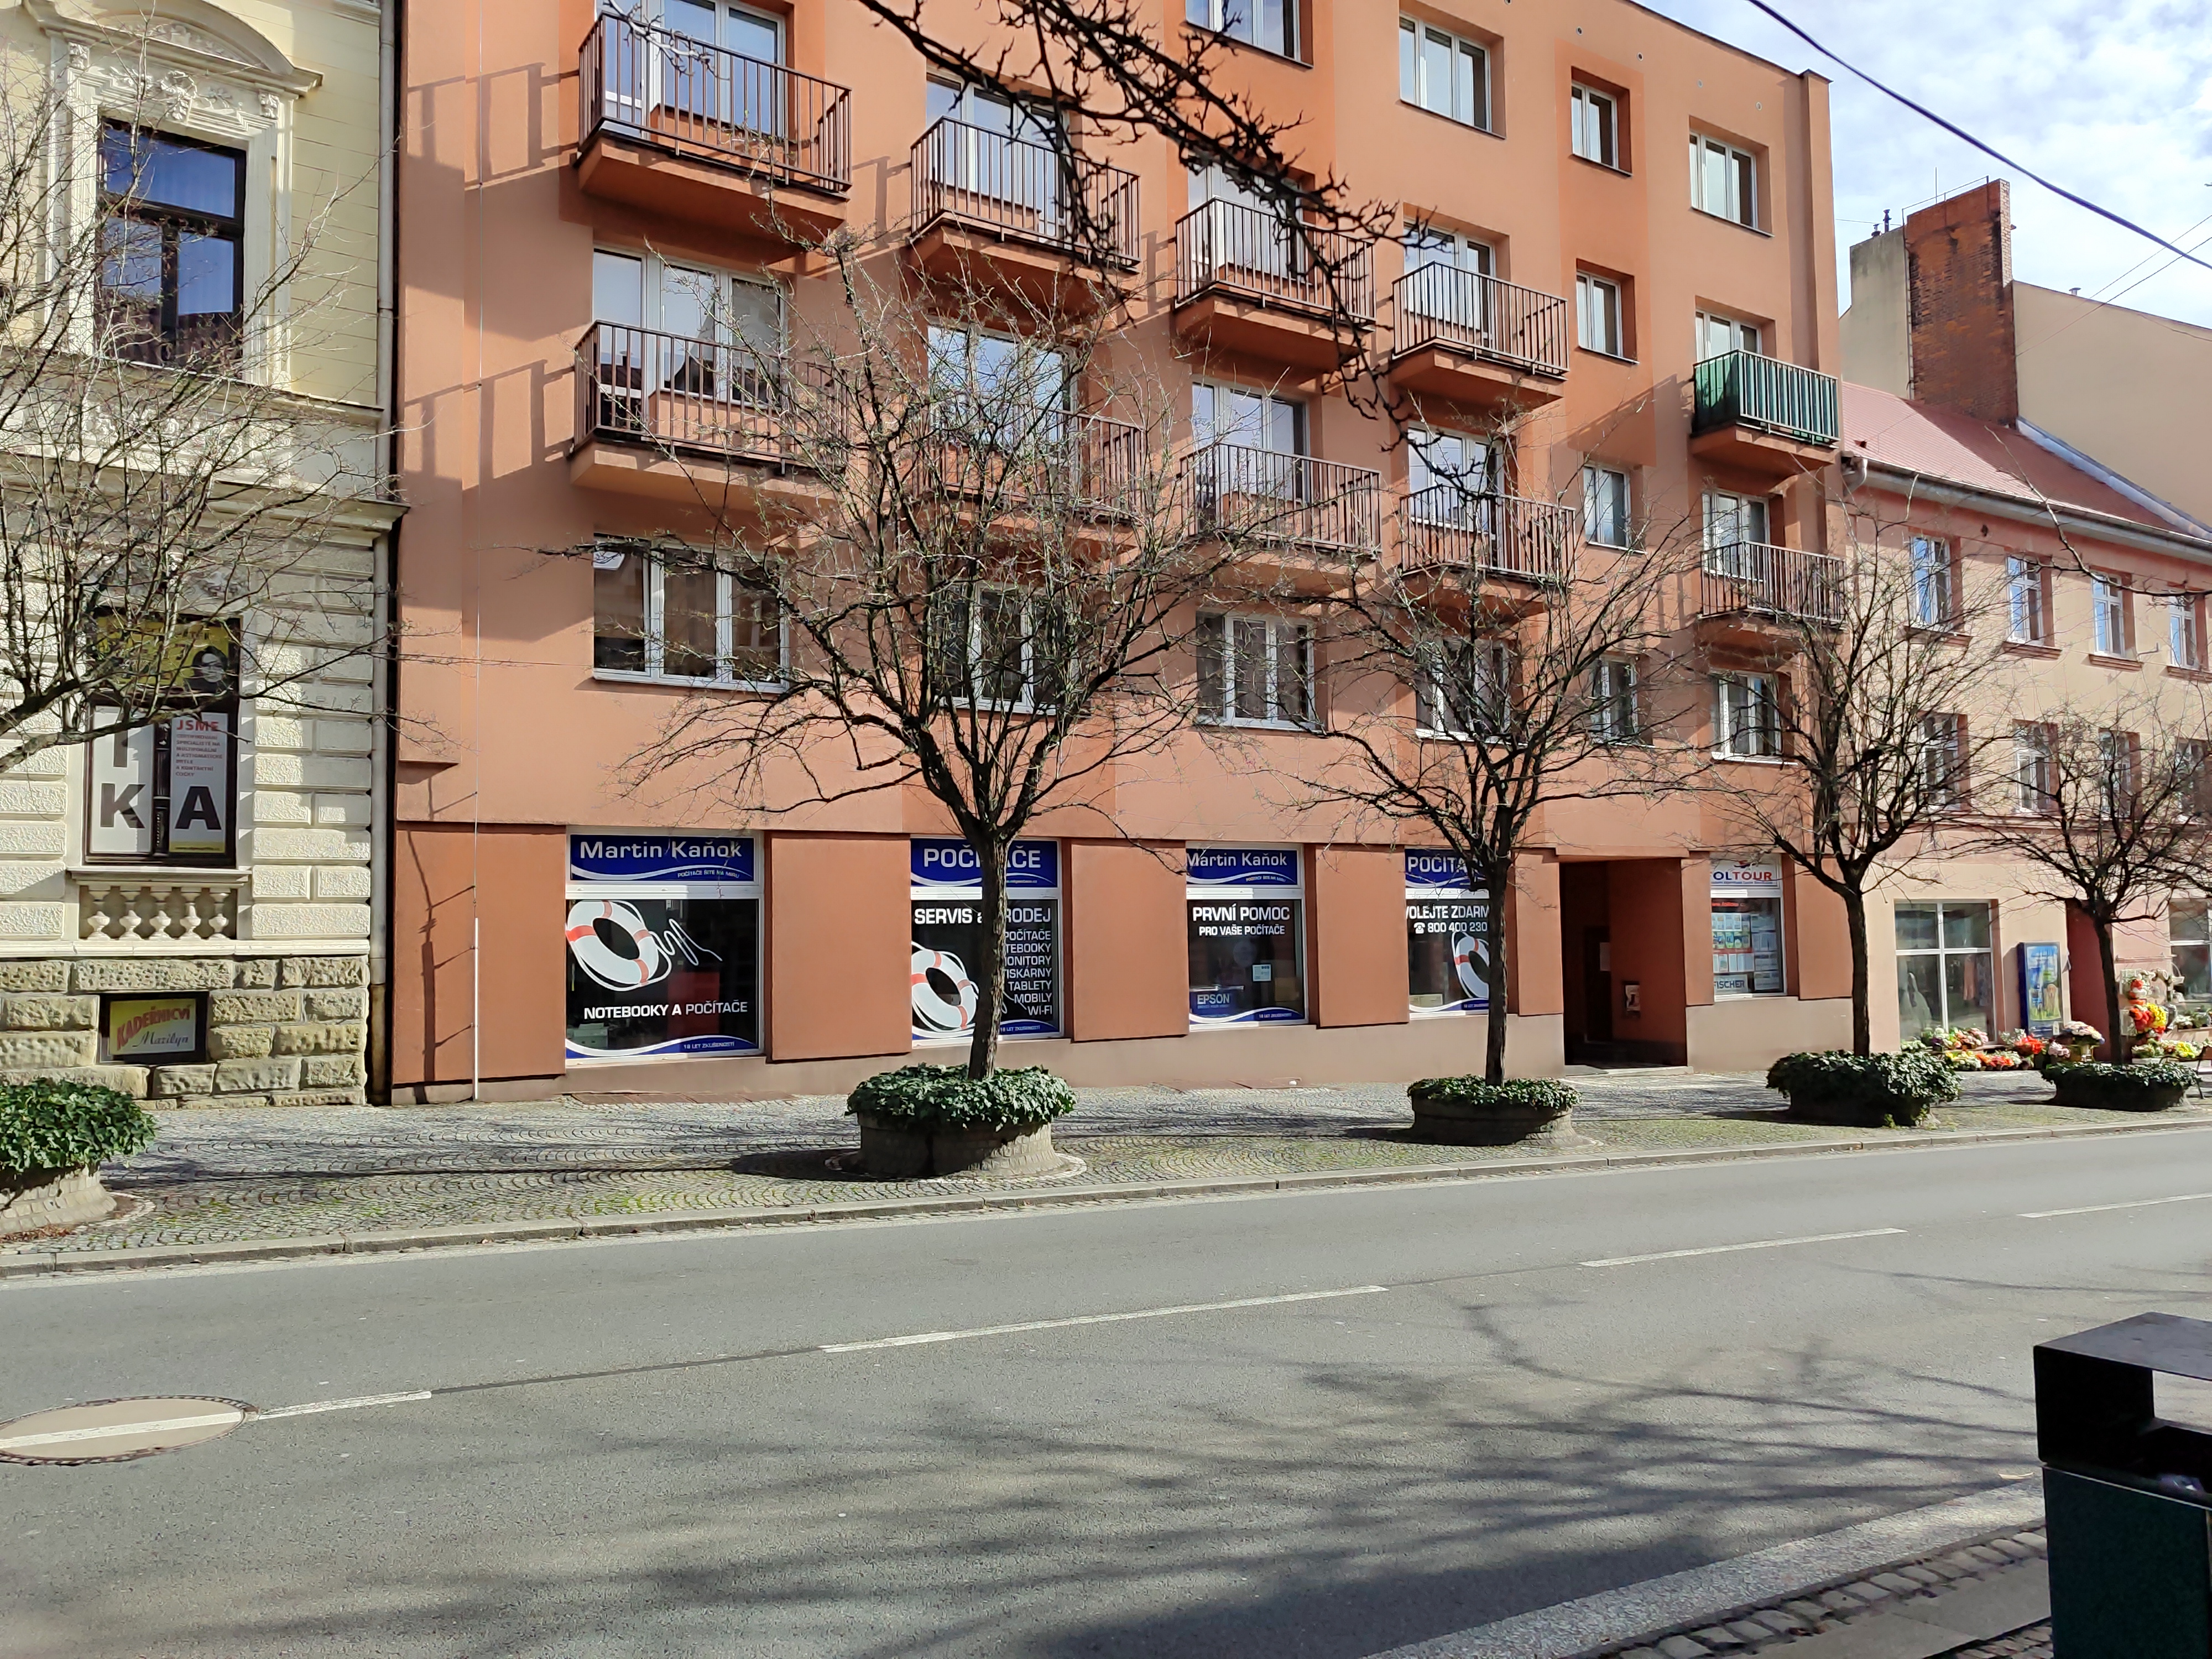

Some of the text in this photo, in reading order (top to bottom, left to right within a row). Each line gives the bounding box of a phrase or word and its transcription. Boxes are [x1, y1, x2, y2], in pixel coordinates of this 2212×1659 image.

[176, 719, 219, 731] JSME
[581, 840, 742, 858] Martin Kaňok
[924, 844, 1041, 868] POČÍČE
[1187, 852, 1287, 867] Martin Kaňok
[1712, 871, 1773, 880] OLTOUR
[914, 908, 972, 924] SERVIS
[1006, 907, 1050, 922] RODEJ
[1193, 902, 1290, 921] PRVNÍ POMOC
[1451, 905, 1489, 919] ZDARM
[1199, 924, 1285, 936] PRO VAŠE POČÍTAČE
[1427, 922, 1488, 933] 800 400 230
[1005, 929, 1051, 941] POČÍTAČE
[1006, 943, 1051, 953] TEBOOKY
[1008, 980, 1052, 991] TABLETY
[1014, 993, 1052, 1003] MOBILY
[1197, 993, 1229, 1004] EPSON
[584, 999, 748, 1020] NOTEBOOKY A POČÍTAČE
[1027, 1005, 1052, 1015] WI-FI
[132, 1030, 189, 1047] Marilyn
